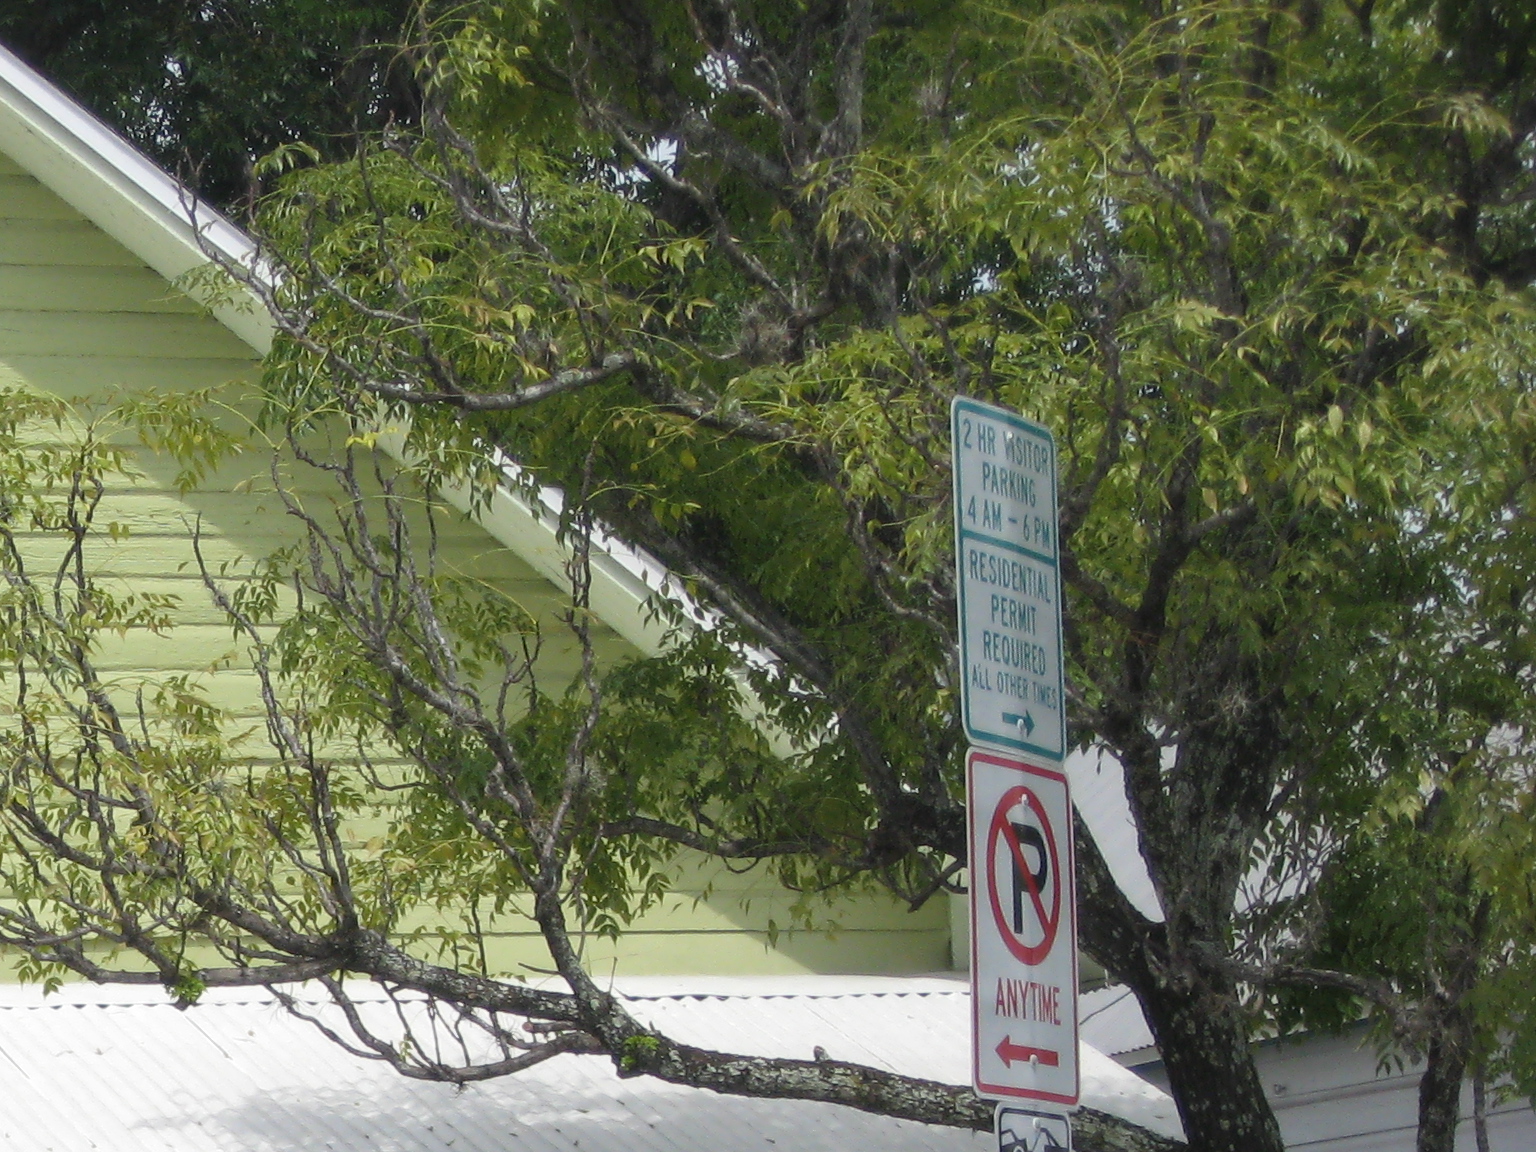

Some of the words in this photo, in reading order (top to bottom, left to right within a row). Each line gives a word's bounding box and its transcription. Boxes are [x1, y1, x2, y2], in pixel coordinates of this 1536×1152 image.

[963, 419, 971, 449] 2
[977, 422, 996, 457] HR
[1002, 431, 1049, 476] VISITOR
[982, 461, 1037, 508] PARKING
[967, 494, 977, 526] 4
[982, 498, 1003, 533] AM
[1022, 513, 1031, 543] 6
[1034, 517, 1051, 549] PM
[969, 549, 1052, 604] RESIDENTIAL
[991, 593, 1037, 636] PERMIT
[983, 630, 1047, 677] REQUIRED
[971, 663, 992, 692] ALL
[996, 670, 1029, 700] OTHER
[1032, 680, 1058, 711] TIMES
[994, 976, 1062, 1027] ANYTIME
